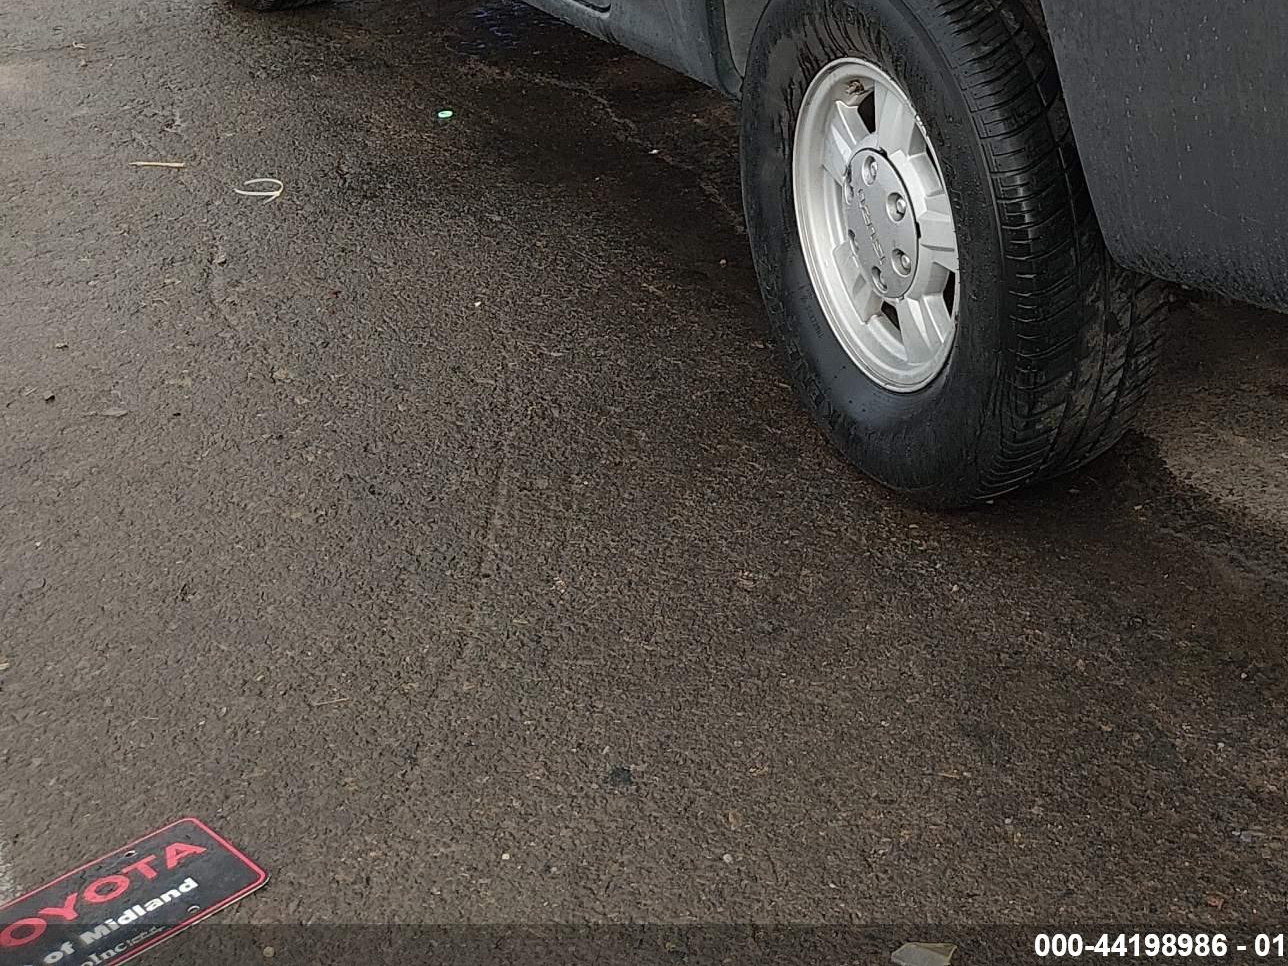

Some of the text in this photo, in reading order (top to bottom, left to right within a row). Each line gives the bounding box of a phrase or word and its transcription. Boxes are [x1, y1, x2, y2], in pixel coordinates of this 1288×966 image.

[0, 842, 207, 947] OYOTA
[44, 941, 75, 965] of
[79, 877, 199, 947] Midland
